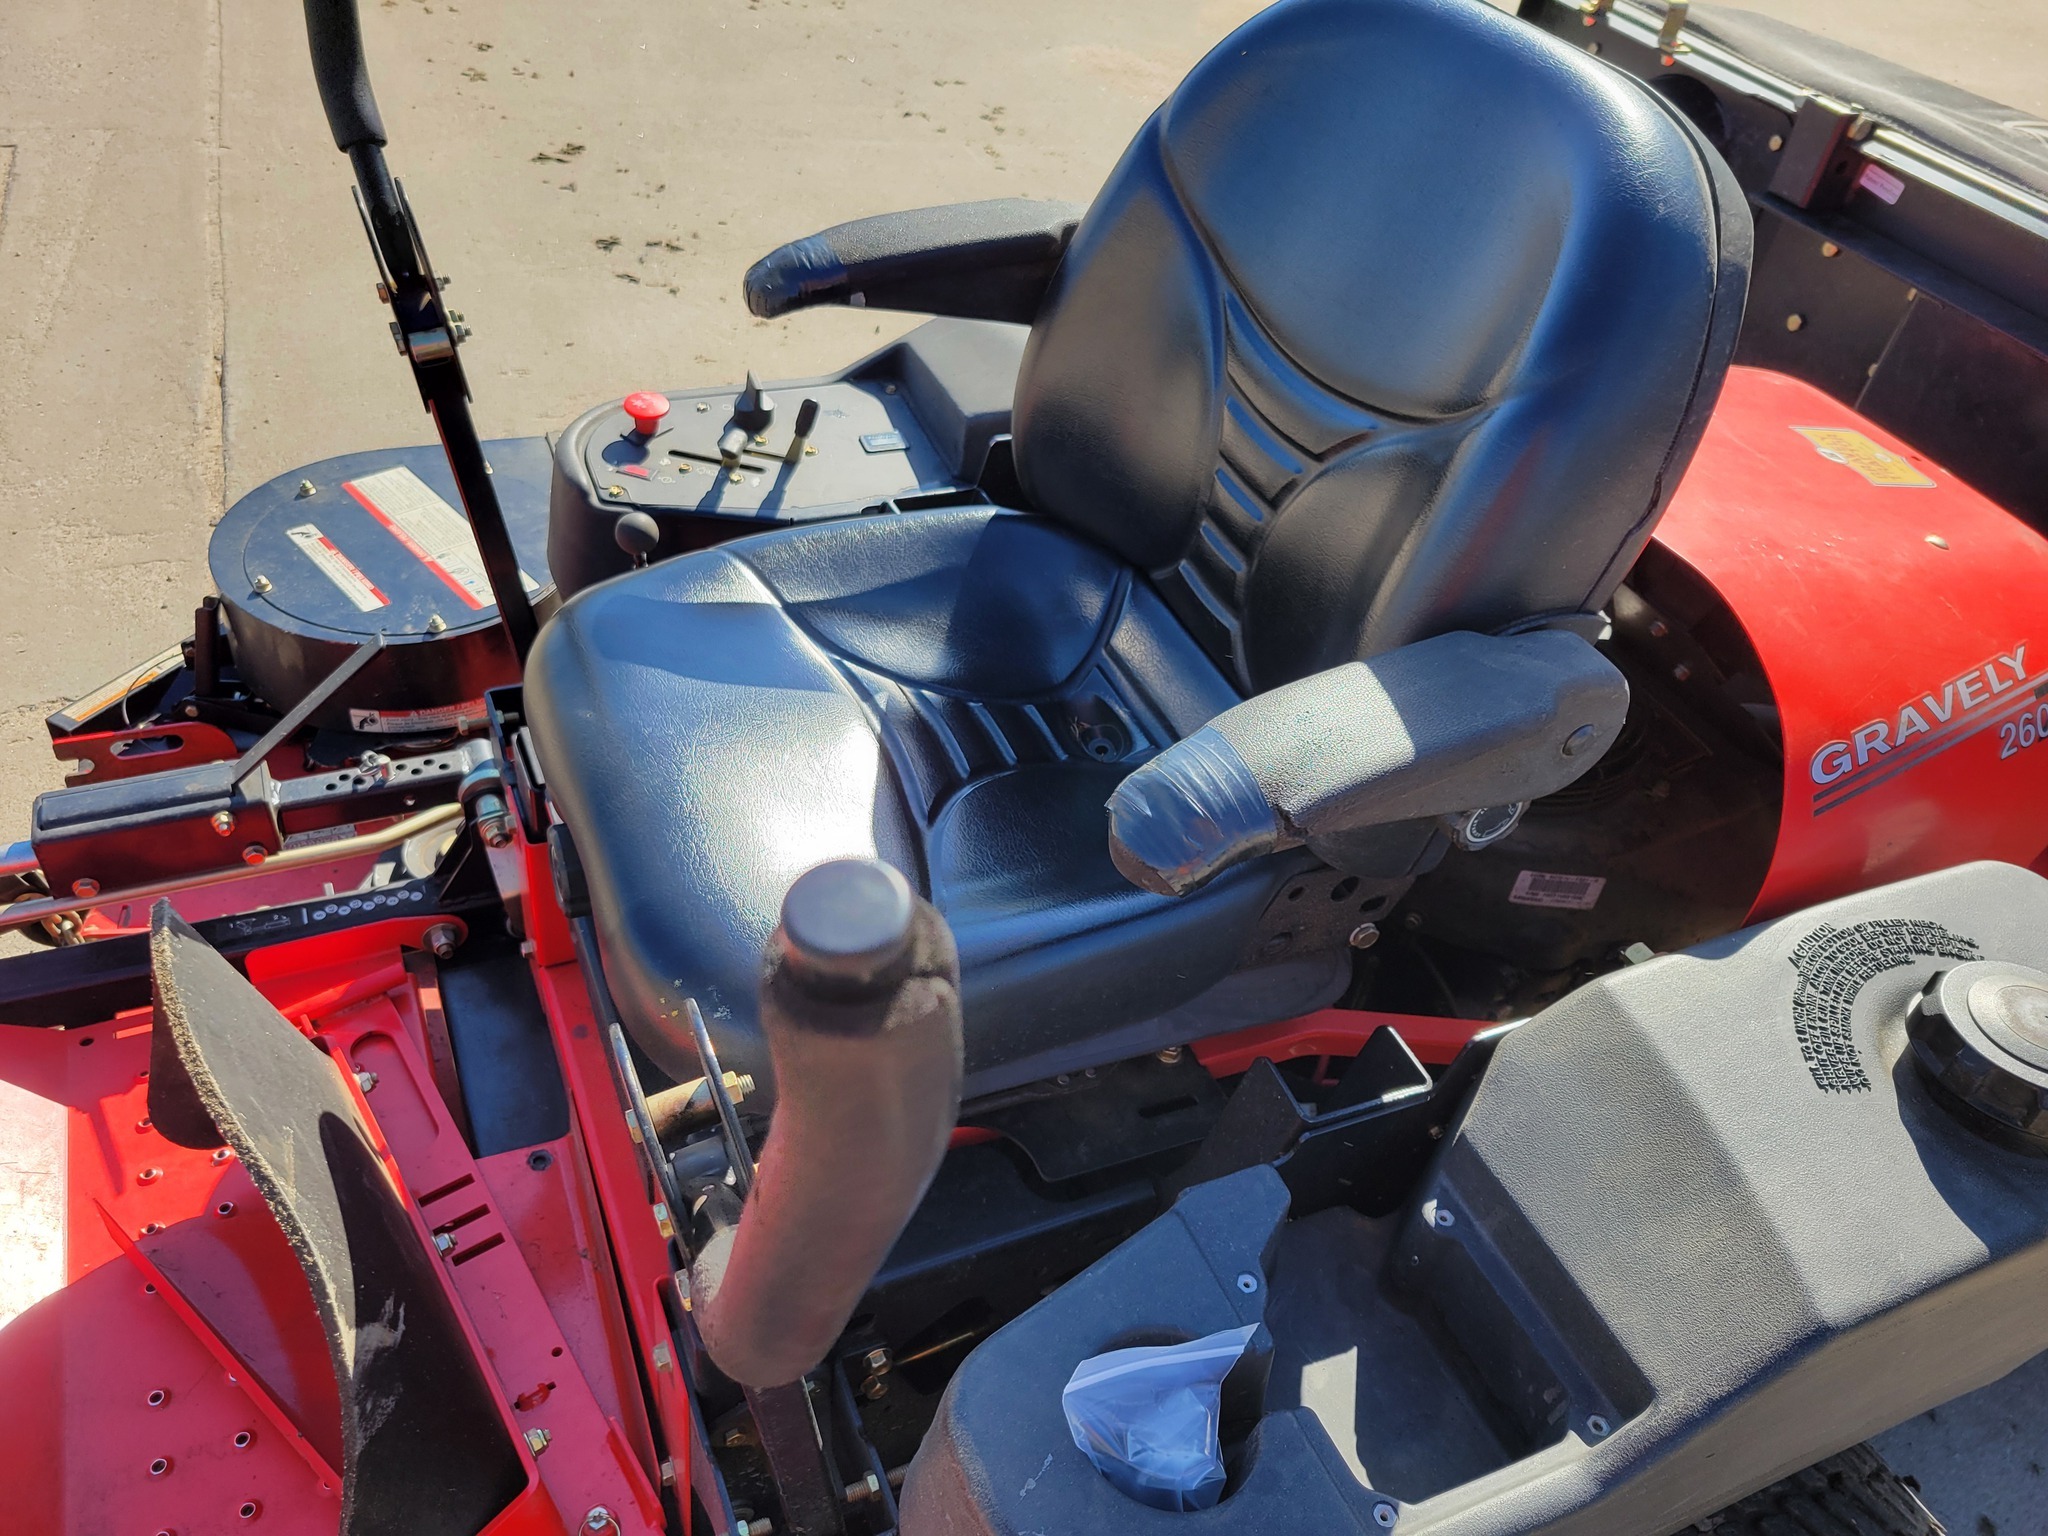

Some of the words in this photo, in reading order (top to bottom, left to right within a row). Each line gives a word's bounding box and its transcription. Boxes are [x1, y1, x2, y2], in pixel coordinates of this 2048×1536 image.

[1811, 646, 2026, 785] GRAVELY
[1793, 922, 1834, 957] CAUTION
[1801, 947, 1824, 978] BELOW
[1818, 927, 1856, 952] BOTTOM
[1853, 922, 1869, 934] OF
[1868, 918, 1909, 931] FILLER
[1809, 959, 1831, 990] ALLOW
[1836, 937, 1863, 955] COOL
[1860, 927, 1907, 942] BEFORE
[1867, 938, 1884, 951] DO
[1884, 933, 1908, 947] NOT
[1833, 974, 1852, 997] FUEL
[1845, 952, 1882, 978] BEFORE
[1880, 944, 1936, 961] STARTING
